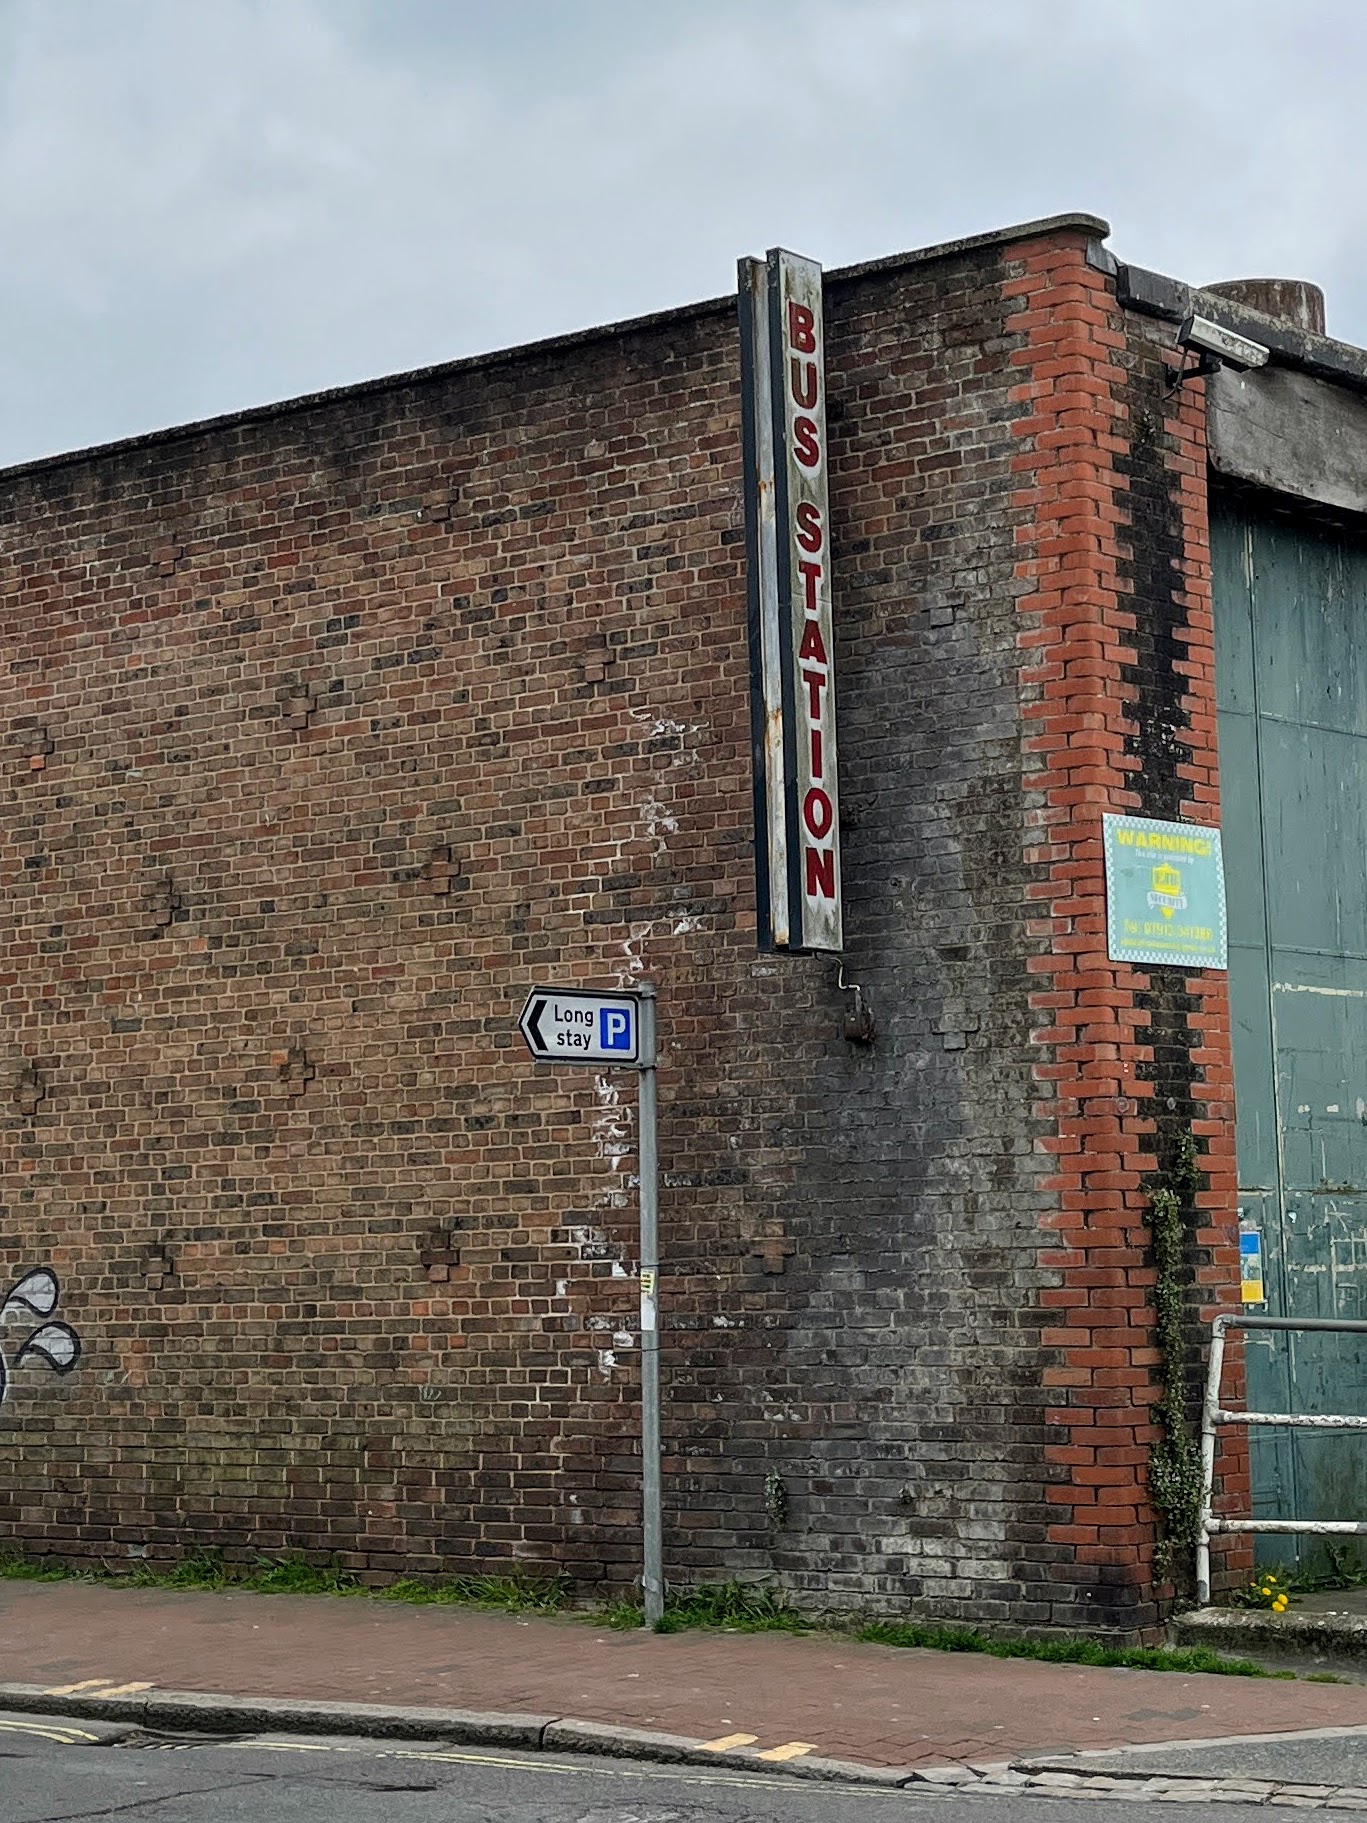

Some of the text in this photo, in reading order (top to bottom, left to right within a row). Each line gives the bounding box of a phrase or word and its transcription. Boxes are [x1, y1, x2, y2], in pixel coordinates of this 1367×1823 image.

[788, 300, 835, 899] BUS STATION
[554, 1004, 594, 1027] Long
[607, 1012, 626, 1046] P
[557, 1029, 592, 1051] stay
